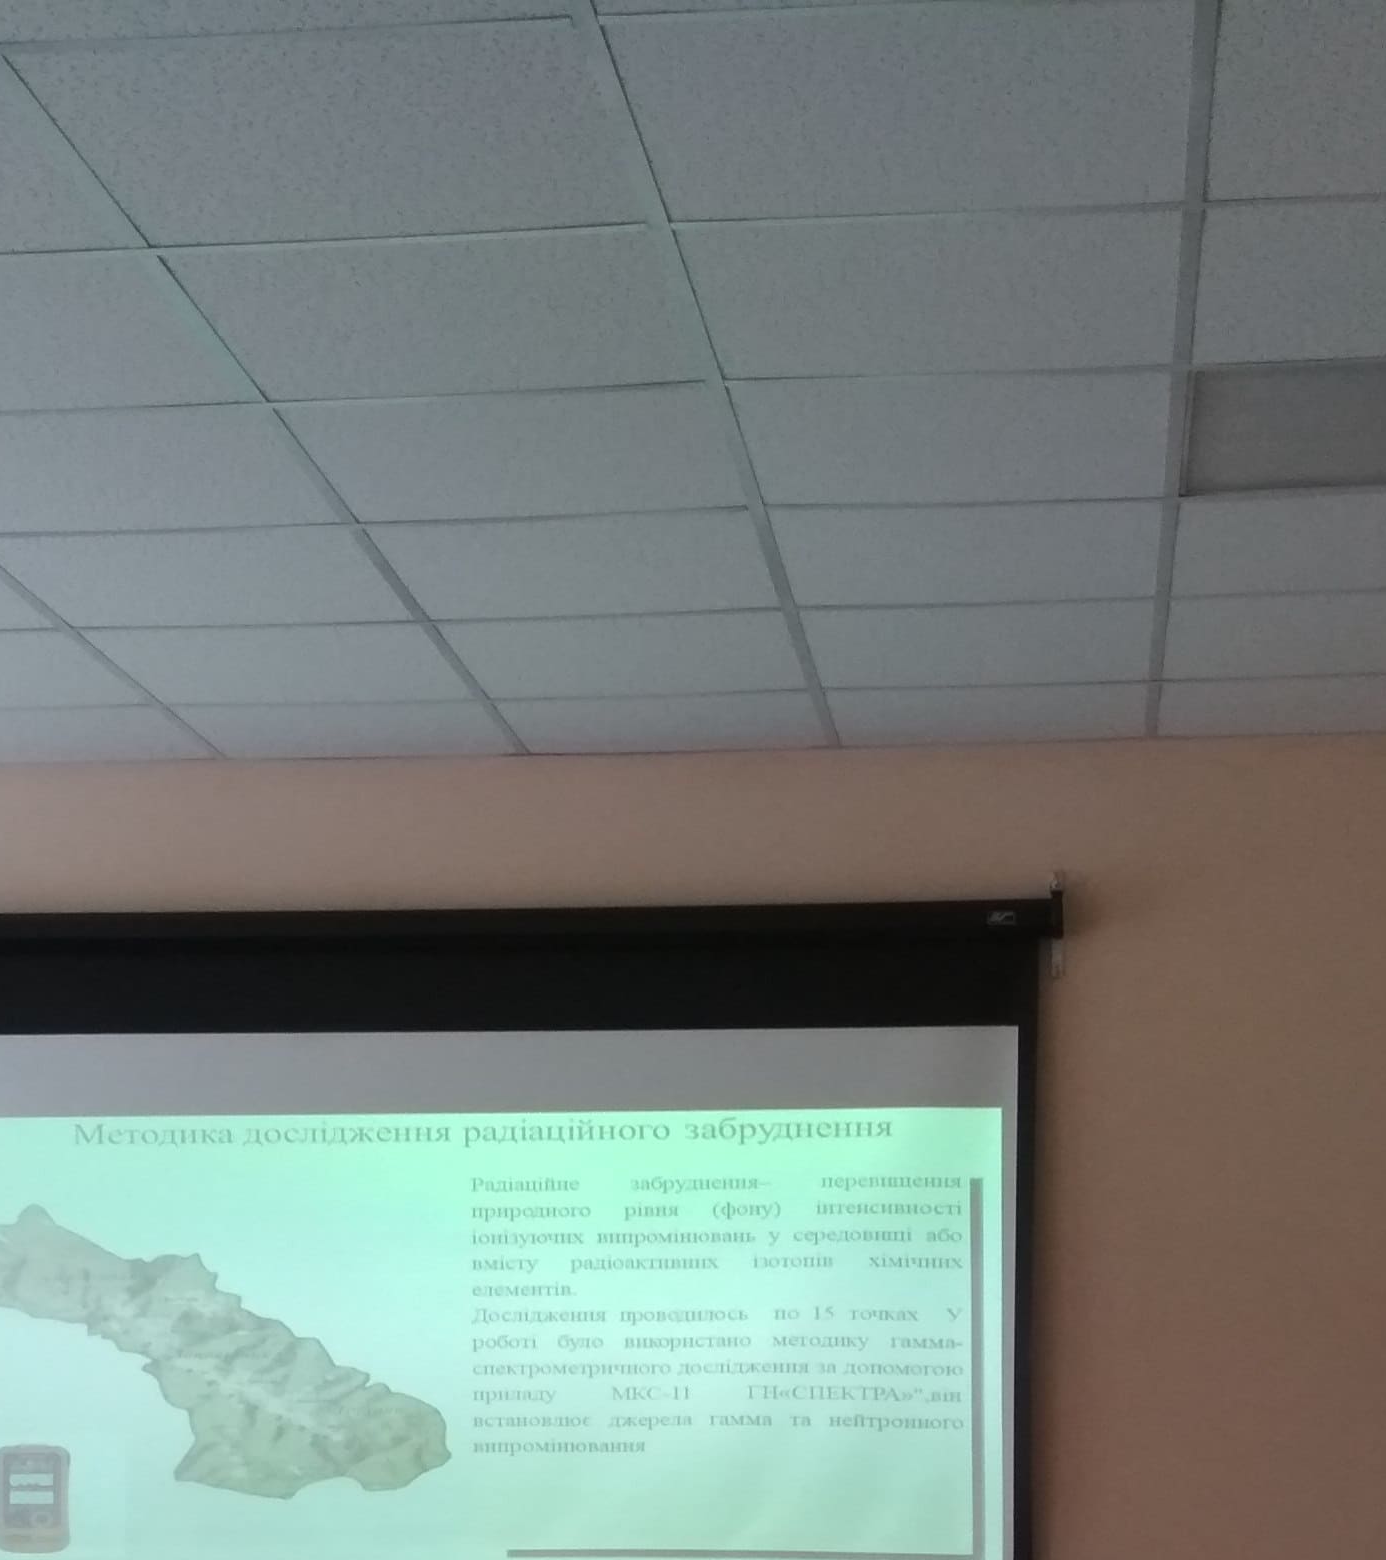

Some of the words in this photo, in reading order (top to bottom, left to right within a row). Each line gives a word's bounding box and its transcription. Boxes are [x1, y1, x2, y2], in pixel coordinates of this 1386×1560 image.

[74, 1122, 232, 1145] Методика
[243, 1120, 450, 1146] дослідження
[464, 1119, 670, 1147] радіаційного
[685, 1117, 893, 1145] забруднення
[472, 1176, 579, 1194] Радіаційне
[821, 1175, 962, 1192] перевищення
[472, 1205, 591, 1221] природного
[624, 1203, 678, 1220] рівня
[712, 1201, 781, 1220] (фону)
[817, 1201, 963, 1217] інтенсивності
[472, 1229, 584, 1248] іонізуючих
[597, 1228, 755, 1246] випромінювань
[769, 1230, 780, 1245] у
[794, 1228, 912, 1246] середовищі
[926, 1228, 962, 1244] або
[472, 1256, 538, 1273] вмісту
[570, 1255, 718, 1273] радіоактивних
[753, 1254, 834, 1270] ізотопів
[869, 1253, 963, 1270] хімічних
[471, 1308, 606, 1325] Дослідження
[620, 1308, 748, 1325] проводилось
[775, 1308, 799, 1320] по
[812, 1306, 834, 1320] 15
[851, 1308, 918, 1321] точках
[472, 1334, 536, 1352] роботі
[557, 1333, 603, 1352] було
[624, 1335, 752, 1352] використано
[773, 1335, 869, 1351] методику
[891, 1336, 964, 1350] гамма-
[472, 1362, 671, 1378] спектрометричного
[677, 1359, 808, 1376] дослідження
[818, 1361, 836, 1374] за
[844, 1361, 964, 1378] допомогою
[473, 1387, 556, 1404] приладу
[473, 1413, 591, 1428] встановлює
[607, 1412, 693, 1430] джерела
[710, 1413, 772, 1427] гамма
[790, 1413, 811, 1427] та
[829, 1412, 964, 1432] нейтронного
[473, 1438, 645, 1455] випромінювання
